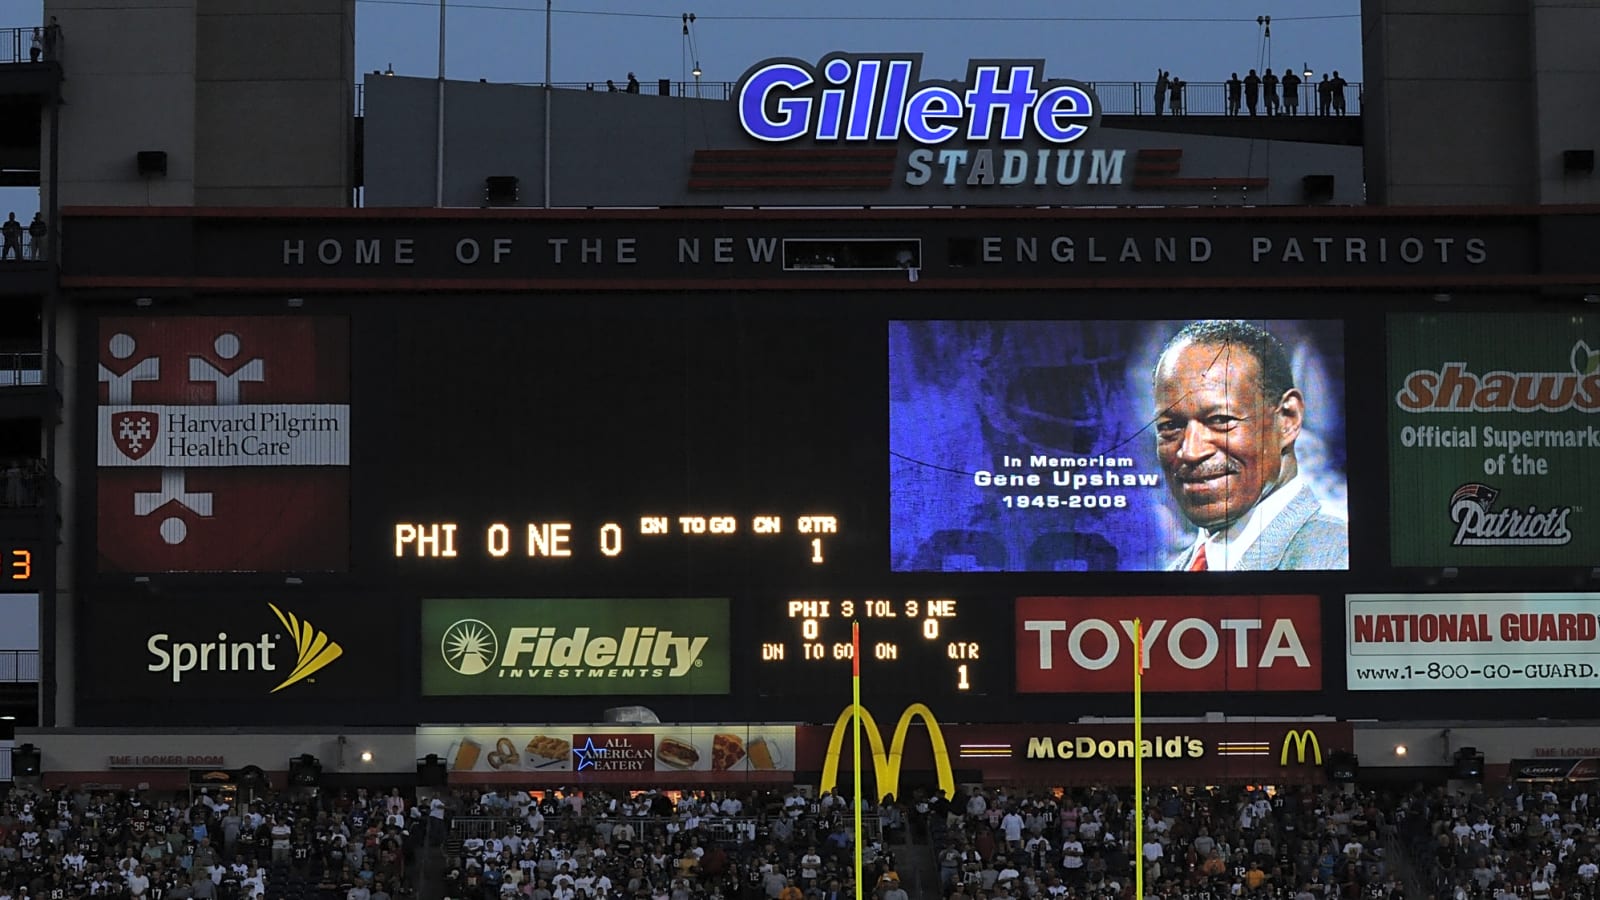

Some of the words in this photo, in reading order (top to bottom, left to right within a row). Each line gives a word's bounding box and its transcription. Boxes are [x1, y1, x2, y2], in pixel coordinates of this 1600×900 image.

[738, 58, 1094, 143] Gillette
[906, 148, 1126, 187] STADIUM
[282, 239, 414, 264] HOME
[455, 238, 512, 264] OF
[548, 238, 637, 264] THE
[678, 237, 778, 263] NEW
[982, 236, 1213, 262] ENGLAND
[1251, 236, 1488, 264] PATRIOTS
[167, 412, 256, 432] Harvard
[260, 412, 339, 437] Pilgrim
[167, 436, 239, 457] Health
[240, 437, 291, 456] Care
[1400, 425, 1477, 448] Official
[1003, 455, 1022, 467] In
[1030, 455, 1133, 467] Memoriam
[1484, 453, 1506, 475] of
[1510, 453, 1549, 475] the
[974, 470, 1041, 487] Gene
[1053, 470, 1159, 490] Upshaw
[1002, 495, 1127, 509] 1945-2008
[679, 516, 707, 534] TO
[708, 516, 737, 534] GO
[797, 515, 837, 534] QTR
[1452, 499, 1572, 545] Patriots
[395, 523, 458, 558] PHI
[527, 523, 572, 558] NE
[812, 538, 825, 563] 1
[11, 550, 31, 579] 3
[788, 600, 830, 618] PHI
[841, 600, 854, 617] 3
[865, 600, 897, 618] TOL
[905, 600, 918, 618] 3
[926, 600, 957, 617] NE
[802, 618, 818, 640] 0
[923, 618, 939, 640] 0
[1354, 613, 1493, 643] NATIONAL
[1500, 613, 1596, 642] GUARD
[501, 627, 709, 676] Fidelity
[803, 642, 825, 660] TO
[833, 643, 853, 660] GO
[875, 643, 897, 660] ON
[947, 642, 979, 659] QTR
[1024, 618, 1311, 670] TOYOTA
[147, 632, 276, 682] Sprint
[498, 669, 664, 677] INVESTMENTS
[957, 664, 970, 690] 1
[582, 749, 653, 759] AMERICAN
[604, 738, 632, 748] ALL
[1027, 735, 1205, 760] McDonald's
[593, 760, 645, 771] EATERY
